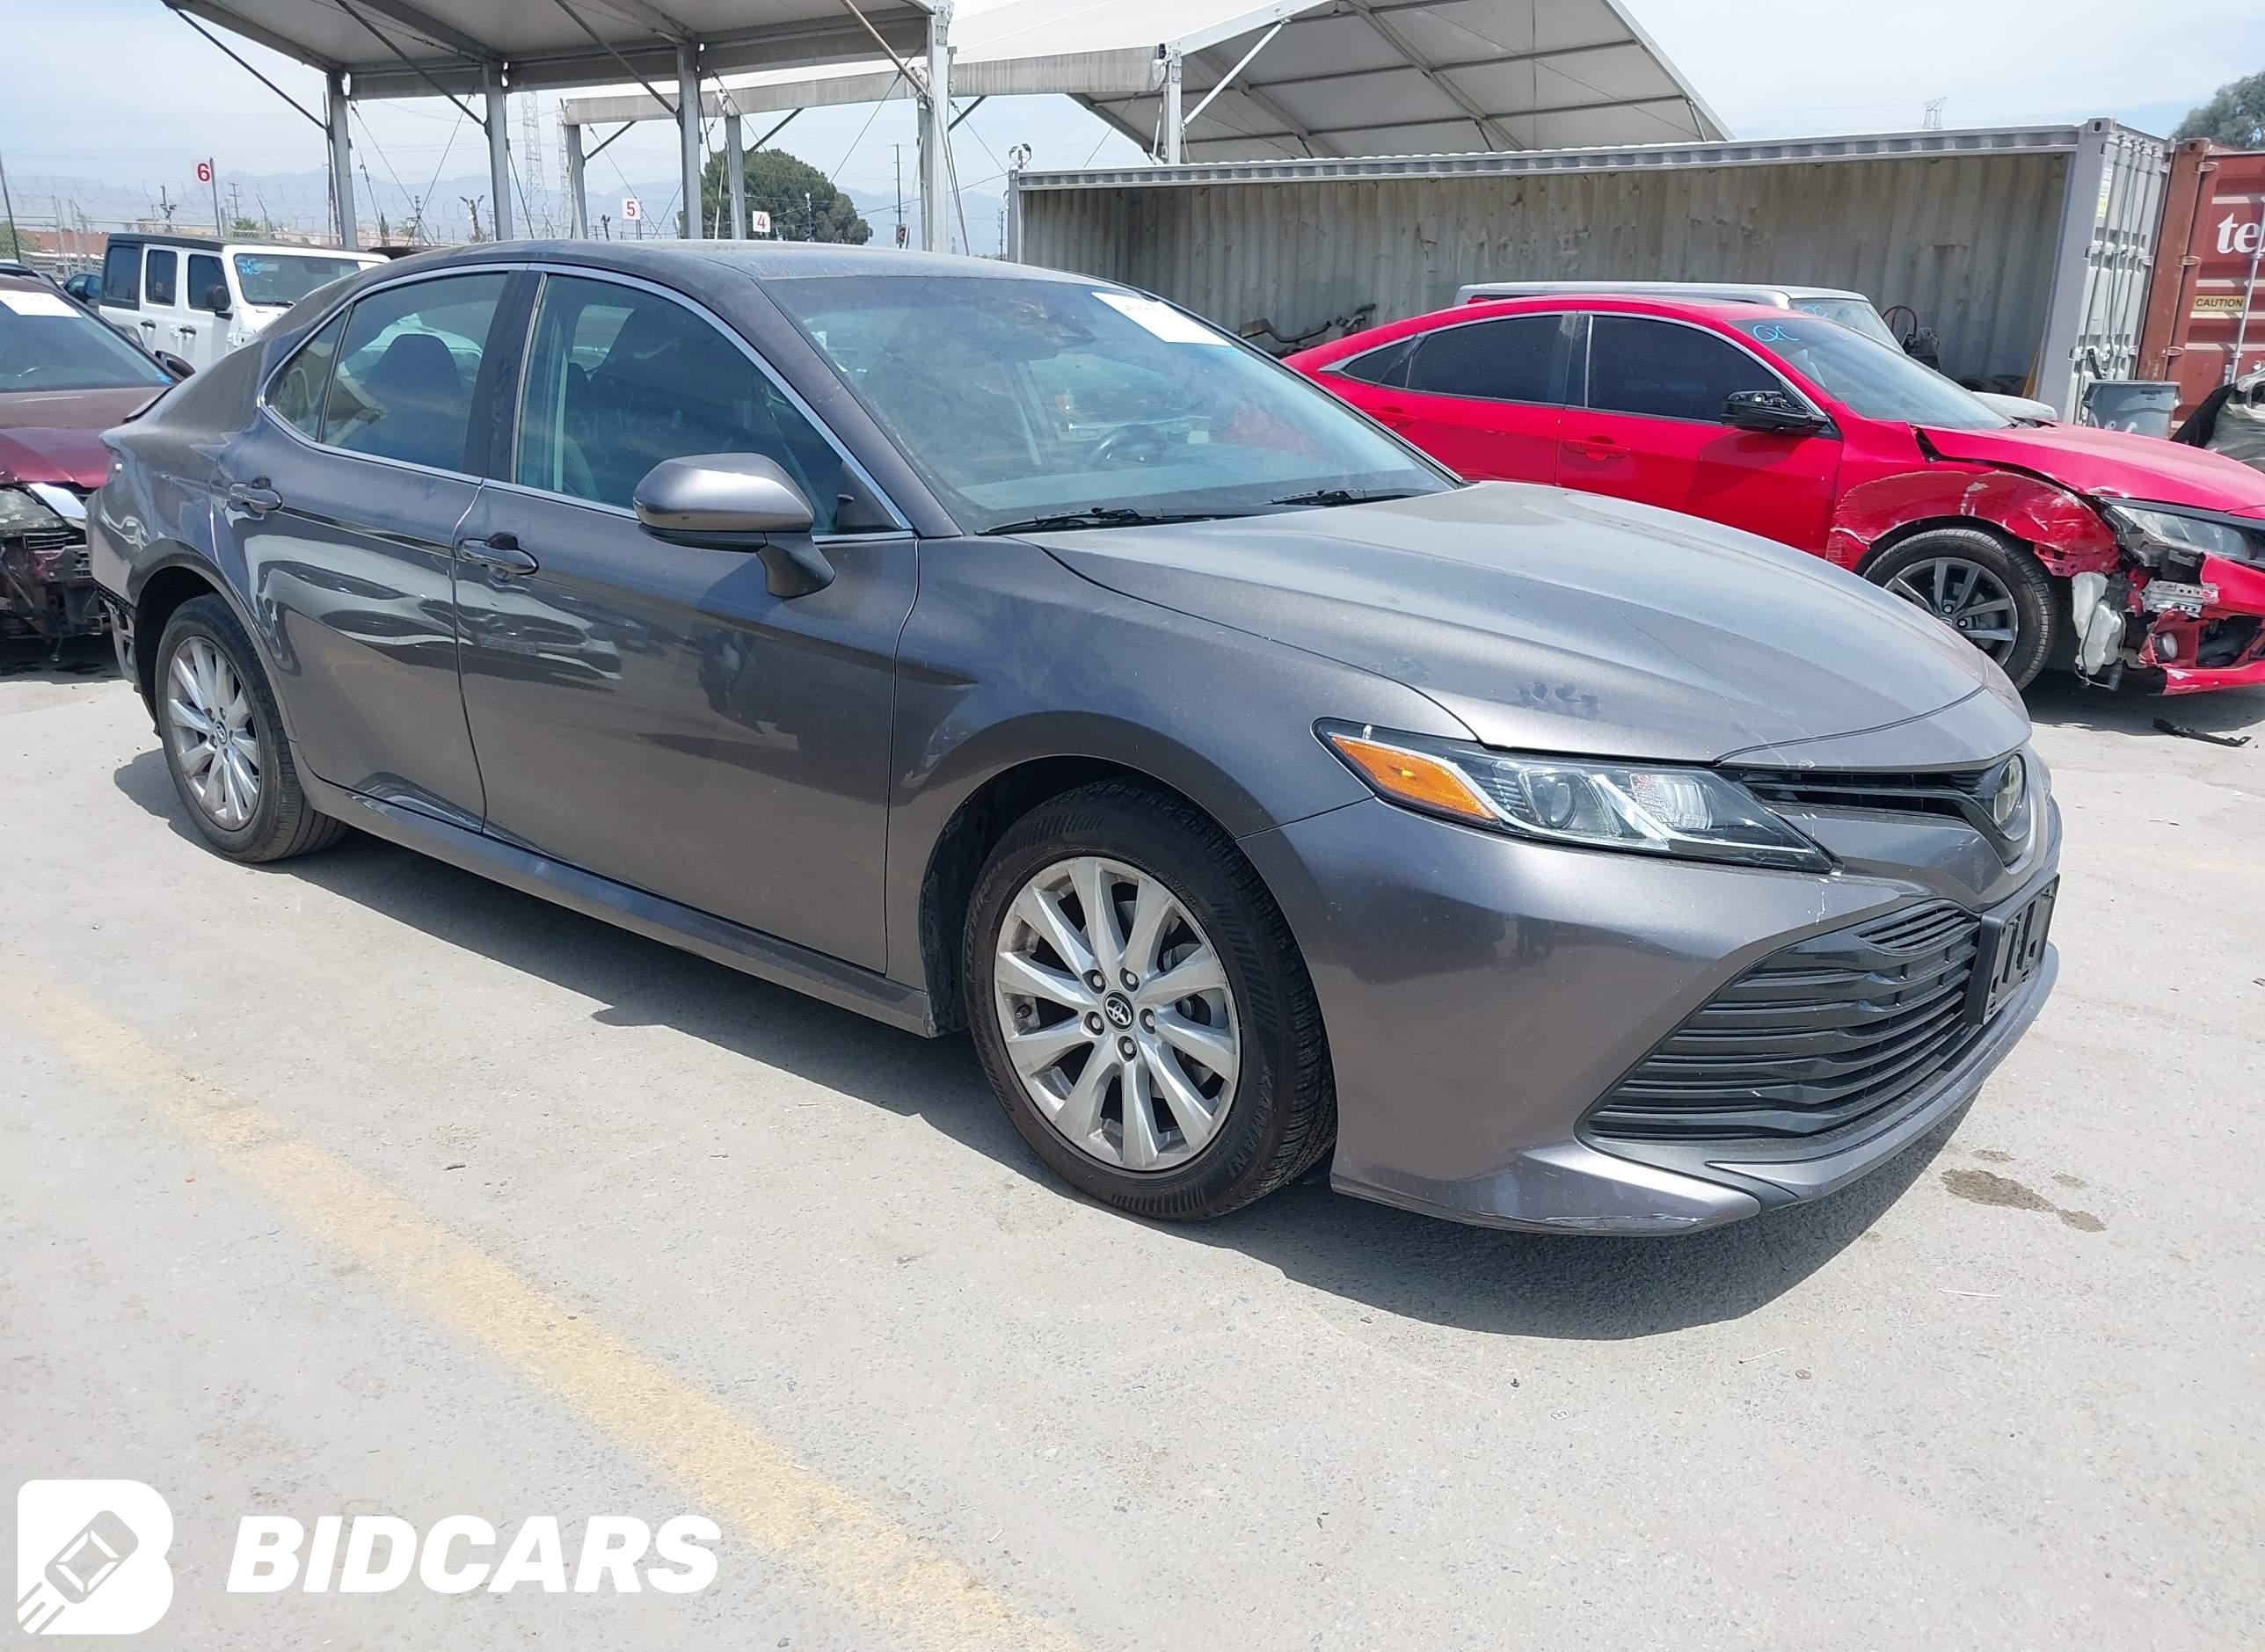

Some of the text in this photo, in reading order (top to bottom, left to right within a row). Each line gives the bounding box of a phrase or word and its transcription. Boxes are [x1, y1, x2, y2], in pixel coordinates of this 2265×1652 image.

[197, 163, 211, 182] 6
[626, 201, 636, 217] 5
[757, 214, 767, 229] 4
[2217, 213, 2265, 254] te
[2196, 298, 2244, 308] CAUTION
